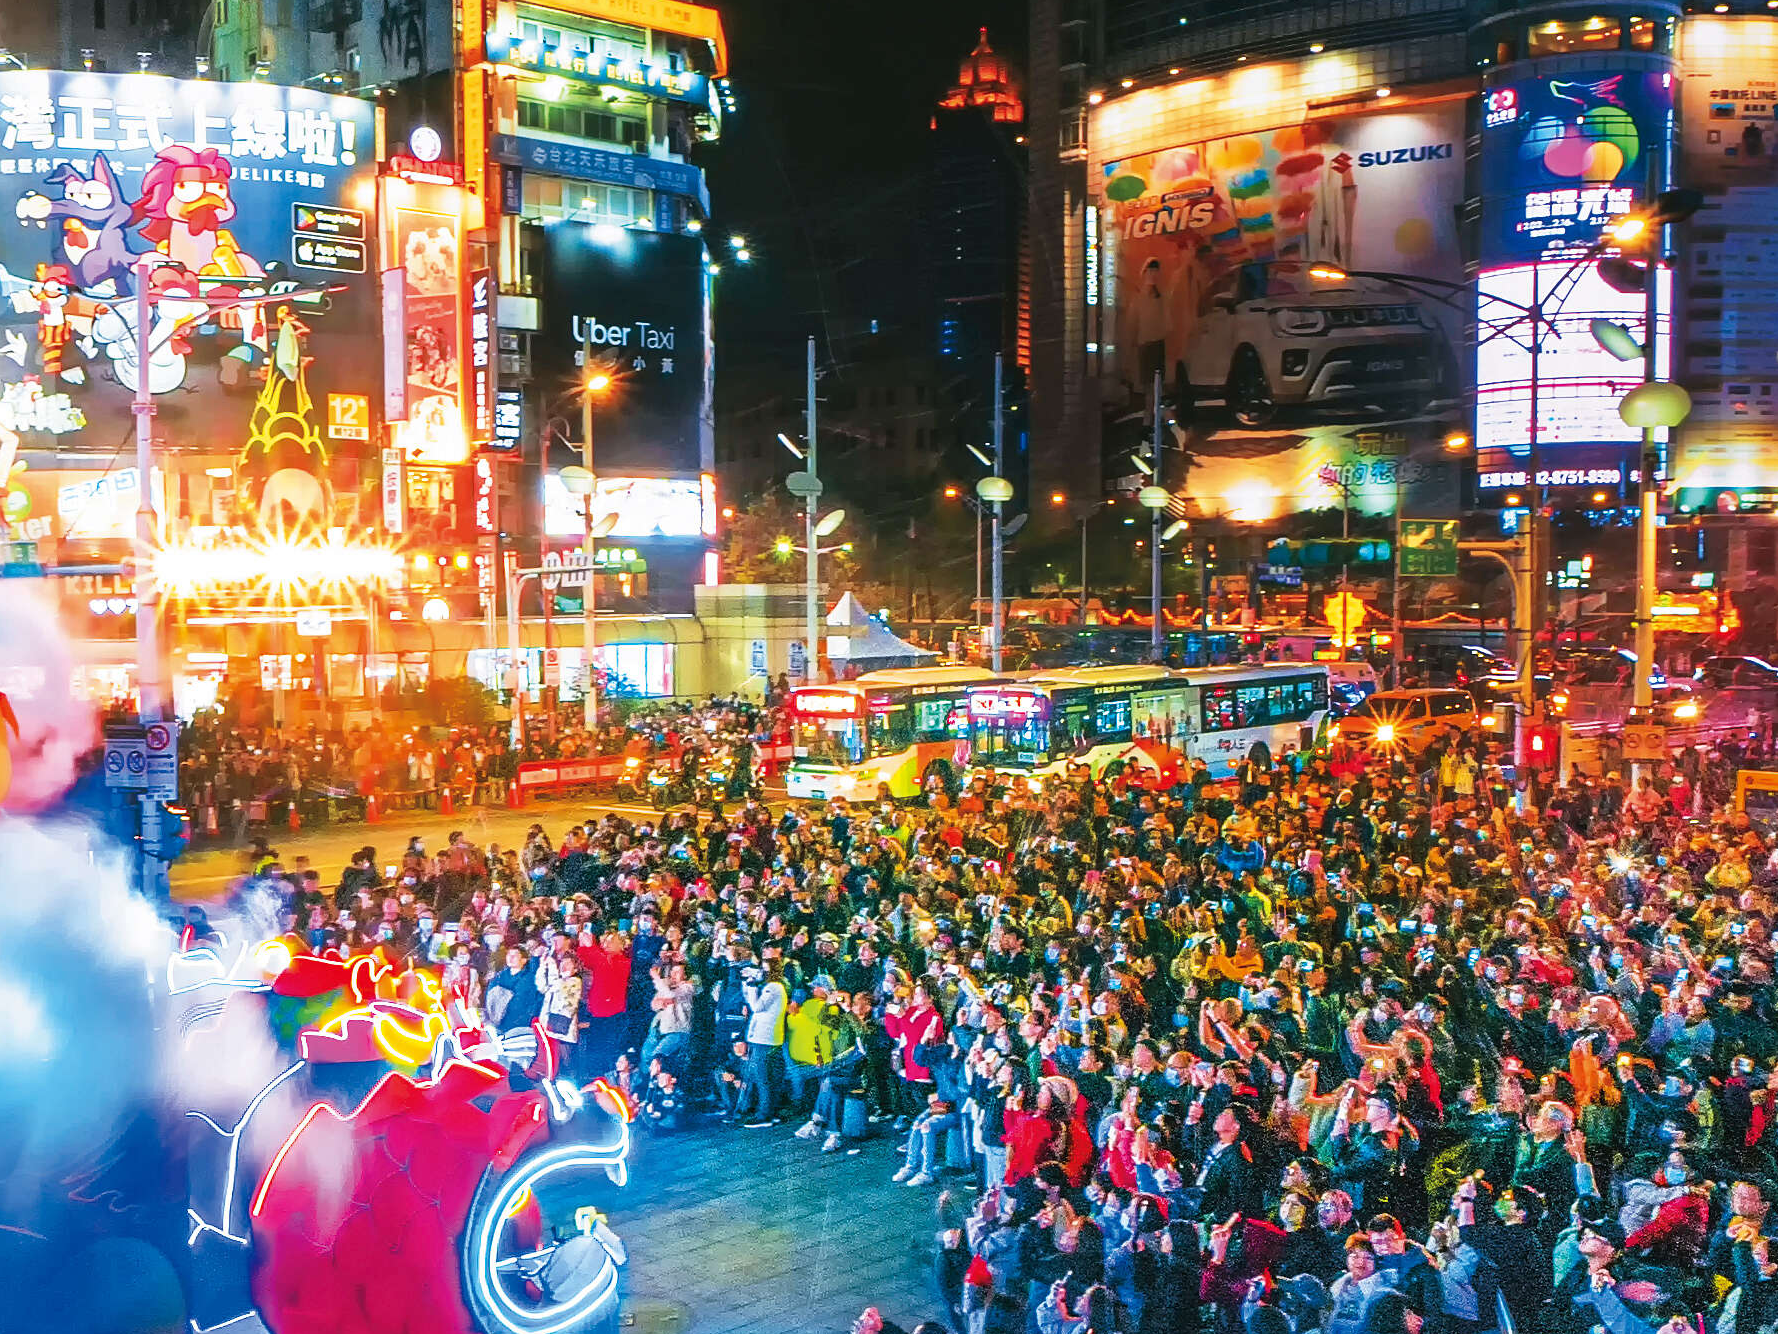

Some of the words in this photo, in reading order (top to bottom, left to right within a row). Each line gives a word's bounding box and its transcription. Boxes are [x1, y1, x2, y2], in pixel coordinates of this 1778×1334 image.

[1358, 143, 1453, 168] SUZUKI
[1123, 202, 1214, 239] IGNIS
[572, 315, 632, 347] Uber
[634, 321, 675, 350] Taxi
[573, 349, 675, 374] 小黃
[64, 574, 138, 595] KILL
